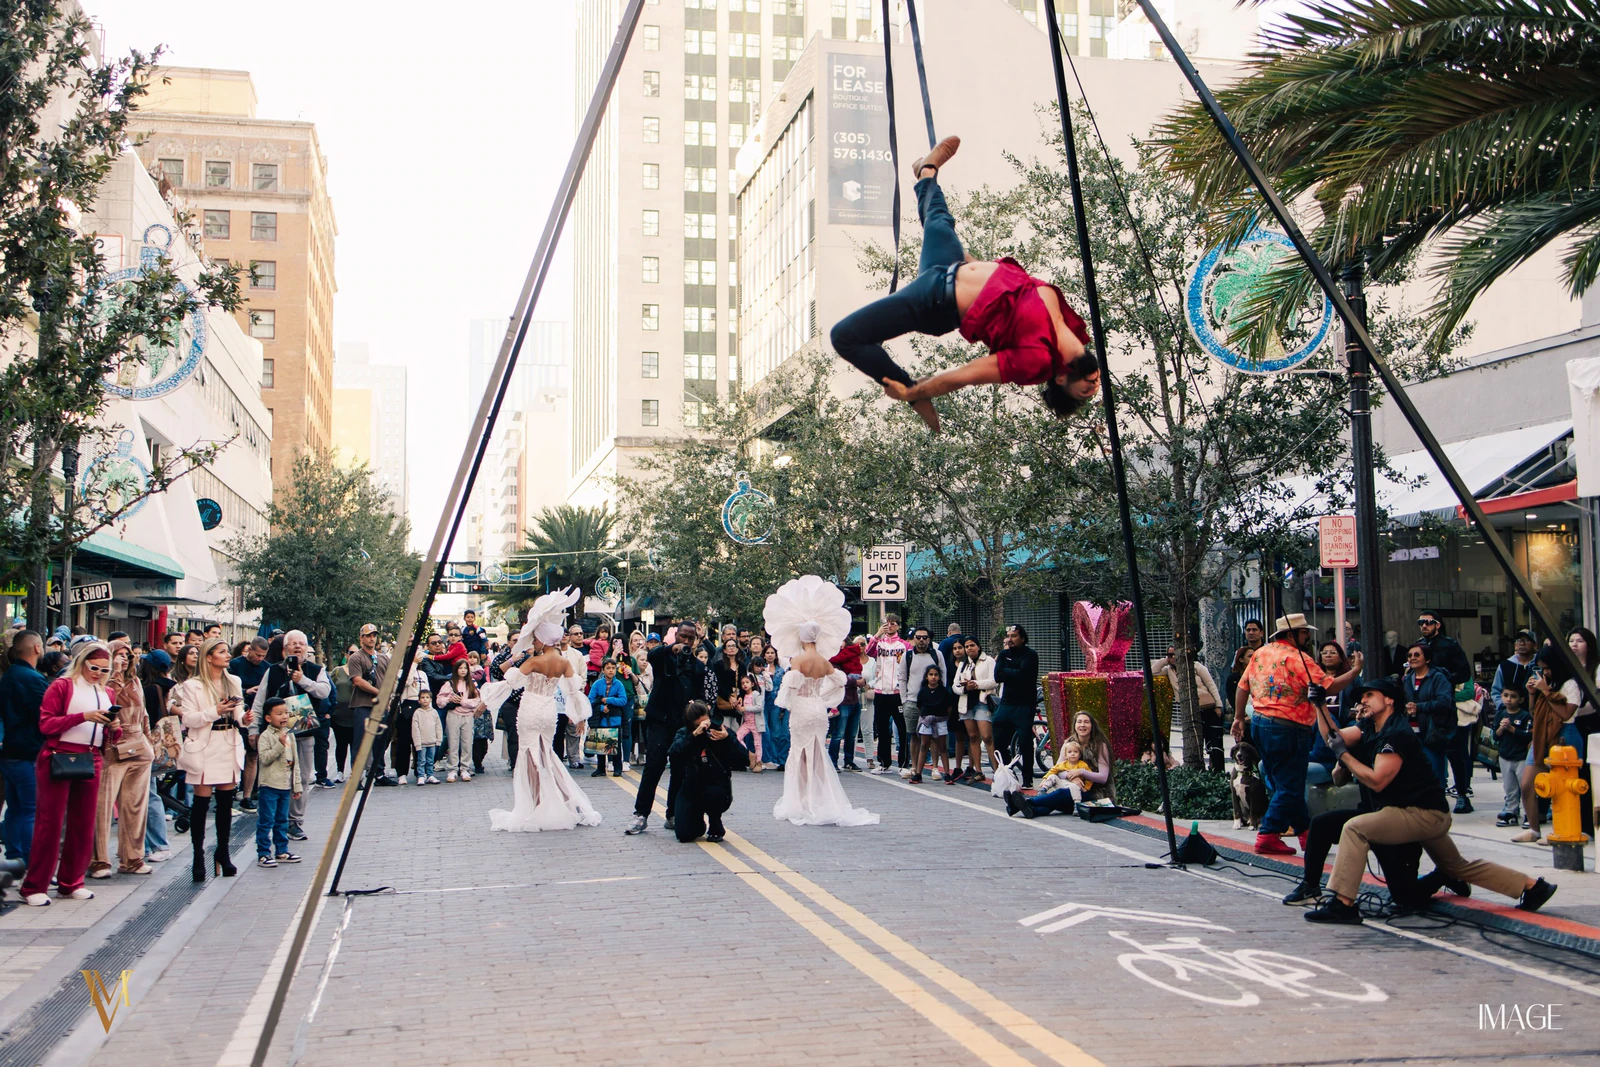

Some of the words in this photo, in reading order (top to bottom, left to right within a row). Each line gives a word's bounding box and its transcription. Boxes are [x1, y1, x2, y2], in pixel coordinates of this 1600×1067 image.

[833, 65, 867, 78] FOR
[833, 79, 884, 94] LEASE
[833, 94, 869, 102] BOUTIQUE
[833, 102, 858, 110] OFFICE
[859, 103, 883, 111] SUITES
[833, 131, 871, 146] (305)
[833, 147, 892, 162] 576.1430
[1331, 518, 1343, 528] NO
[1323, 528, 1353, 536] STOPPING
[1333, 535, 1343, 543] OR
[1323, 542, 1353, 550] STANDING
[865, 551, 902, 560] SPEED
[869, 562, 898, 572] LIMIT
[867, 574, 901, 594] 25
[82, 584, 108, 601] SHOP
